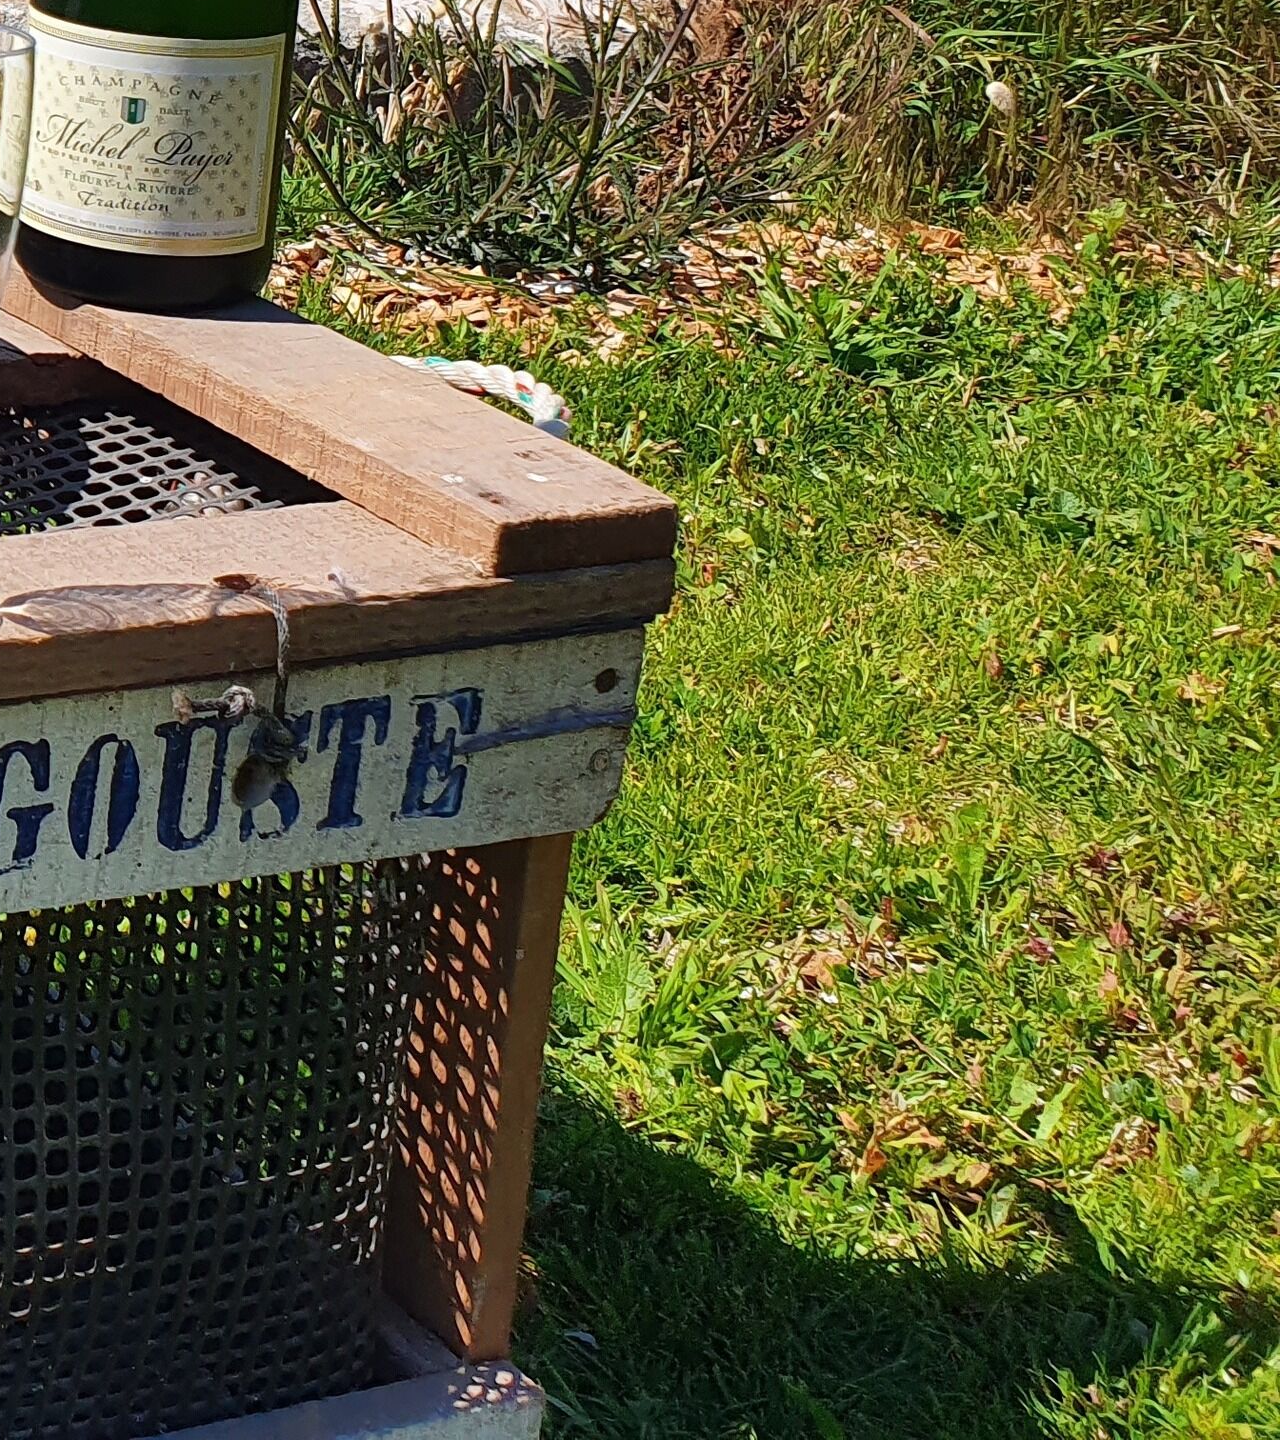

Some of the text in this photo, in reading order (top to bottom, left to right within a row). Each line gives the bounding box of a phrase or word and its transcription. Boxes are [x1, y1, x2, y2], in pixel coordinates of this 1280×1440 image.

[58, 75, 223, 106] CHAMPAGNE
[36, 114, 151, 160] Michel
[77, 190, 170, 212] Tradition
